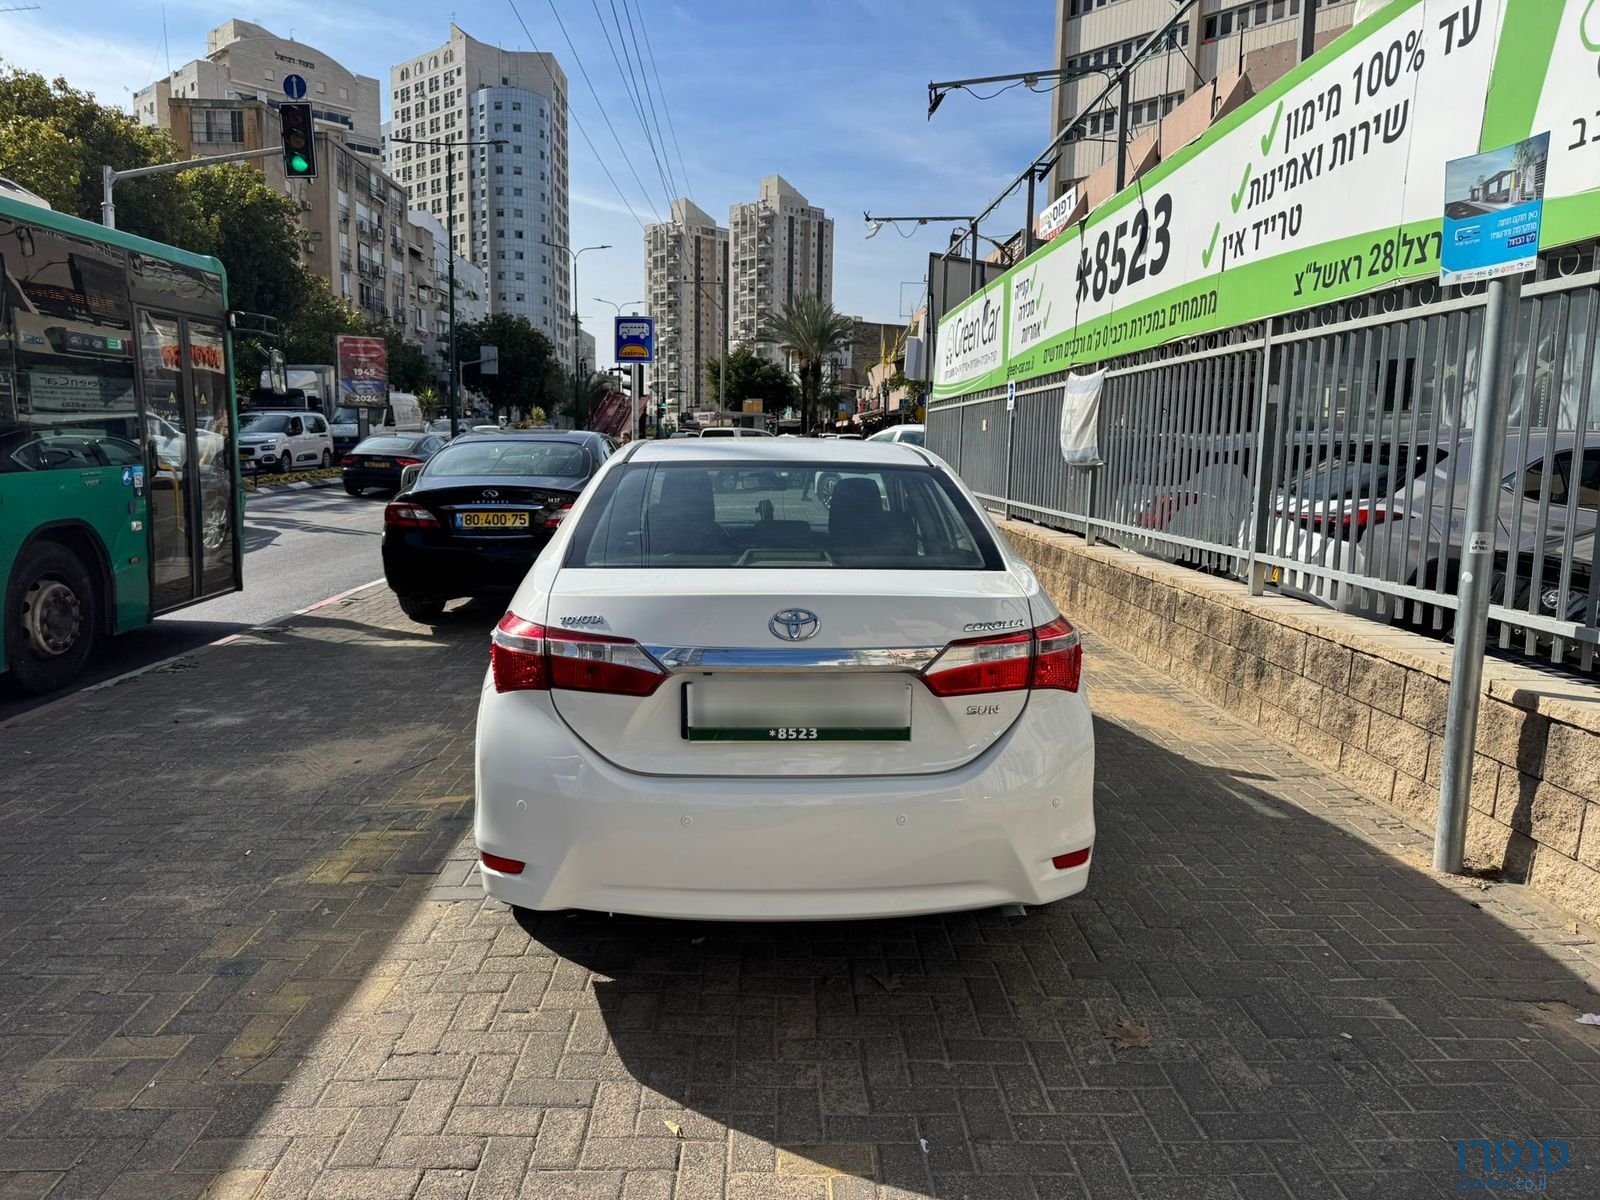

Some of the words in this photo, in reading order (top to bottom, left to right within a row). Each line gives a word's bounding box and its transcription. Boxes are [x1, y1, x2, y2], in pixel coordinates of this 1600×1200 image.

[1439, 0, 1482, 56] עד
[1353, 29, 1425, 105] 100%
[1285, 84, 1341, 154] מימון
[1329, 99, 1409, 171] שירות
[1247, 144, 1323, 209] ואמינות
[1053, 194, 1072, 221] דפוס
[1252, 203, 1302, 250] טרייד
[1222, 228, 1247, 272] אין
[1368, 239, 1394, 277] 28
[1018, 299, 1034, 322] מכירה
[1129, 308, 1166, 339] במכירת
[1169, 290, 1217, 326] מתמחים
[955, 317, 980, 358] Green
[981, 299, 1001, 345] Car
[1021, 320, 1041, 344] אחריות
[1043, 344, 1063, 364] חדשים
[353, 368, 376, 376] 1945
[354, 395, 378, 403] 2024
[560, 615, 604, 625] TOYOTA
[963, 619, 1025, 632] COROLLA
[966, 705, 1000, 715] SUN
